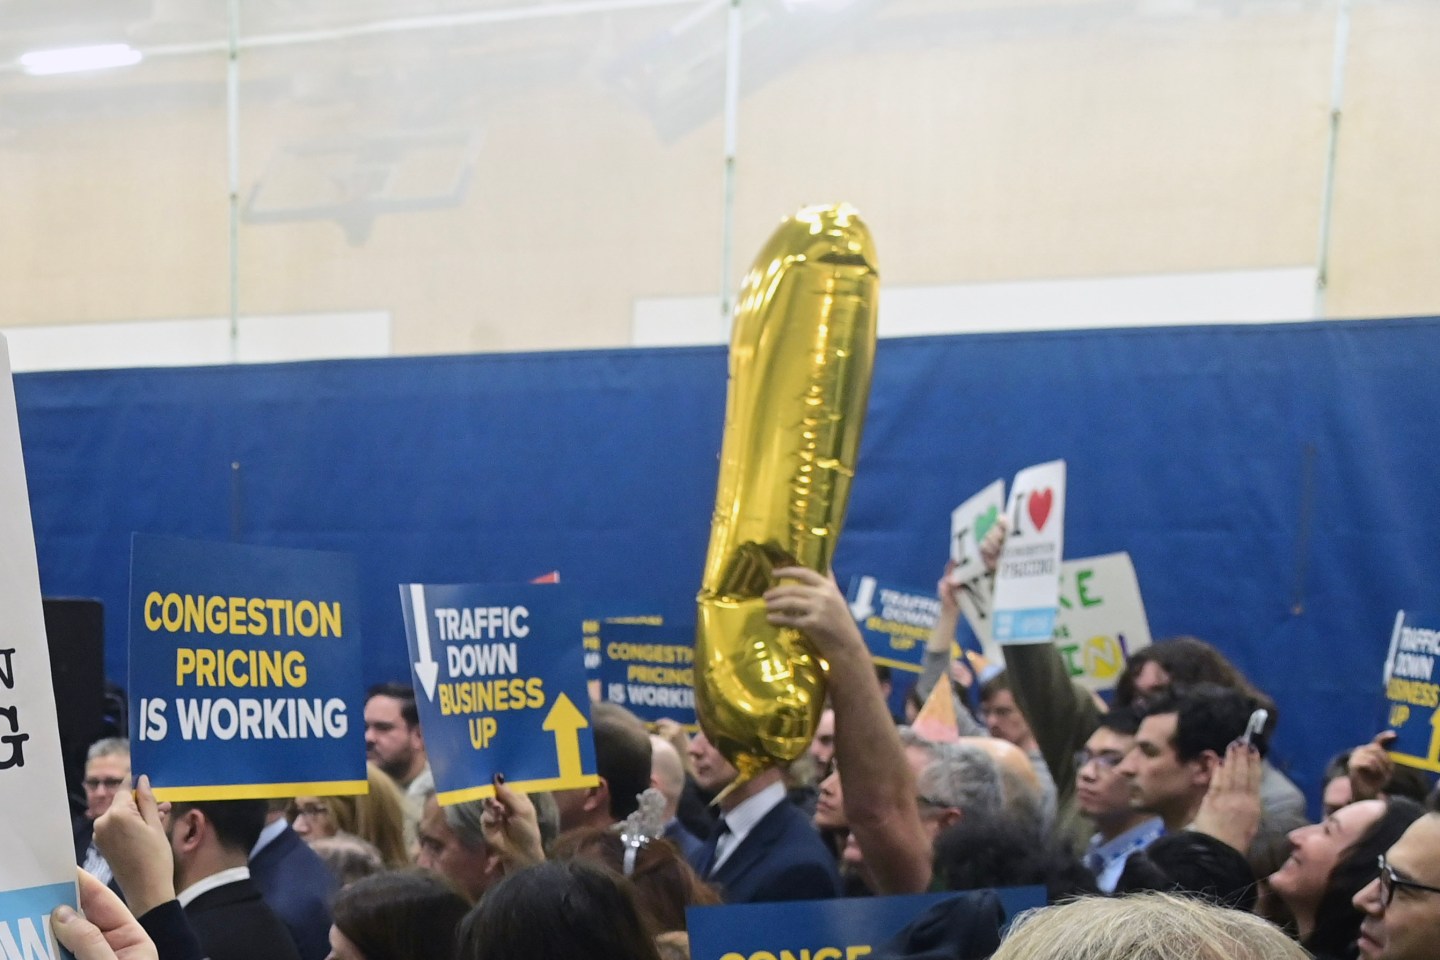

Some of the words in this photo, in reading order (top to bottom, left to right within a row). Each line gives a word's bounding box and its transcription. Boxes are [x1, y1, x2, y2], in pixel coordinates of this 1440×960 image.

[143, 591, 342, 637] CONGESTION
[435, 606, 530, 640] TRAFFIC
[176, 649, 308, 688] PRICING
[446, 643, 517, 678] DOWN
[438, 677, 545, 715] BUSINESS
[607, 682, 626, 704] IS
[139, 697, 168, 742] IS
[174, 697, 349, 741] WORKING
[469, 718, 498, 750] UP
